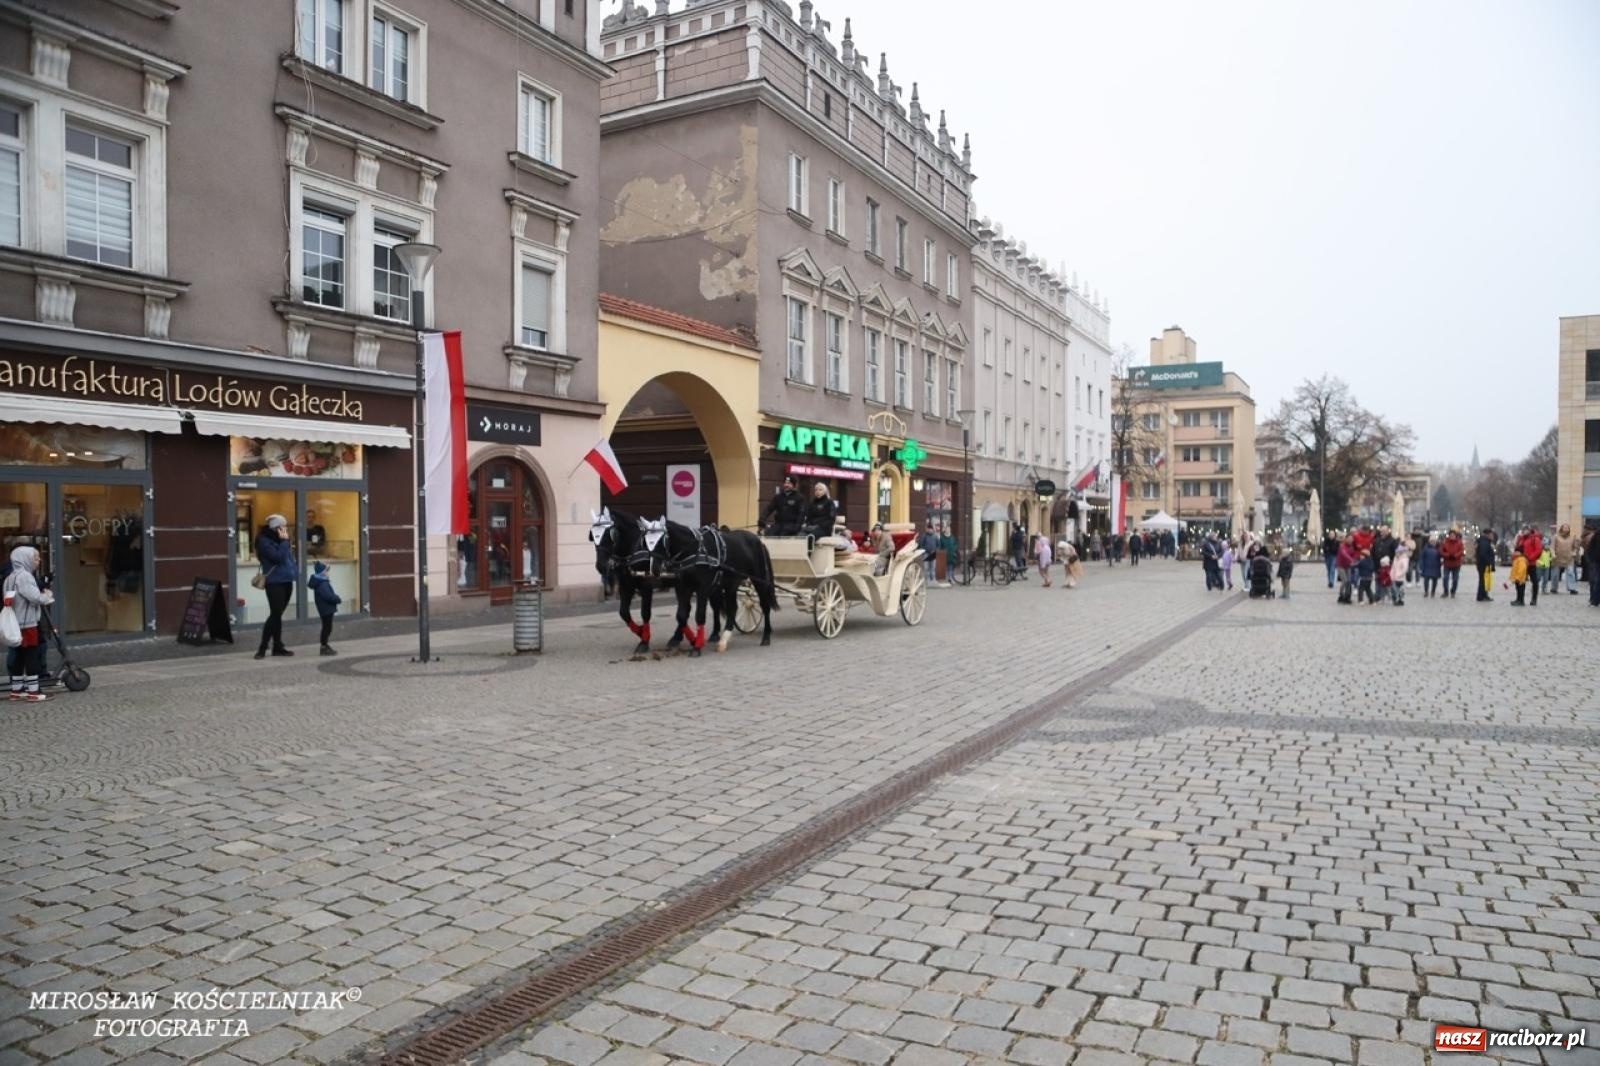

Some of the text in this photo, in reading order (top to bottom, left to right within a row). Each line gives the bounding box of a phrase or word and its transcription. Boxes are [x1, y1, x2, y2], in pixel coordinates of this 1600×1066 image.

[1151, 371, 1199, 381] McDonald's
[175, 374, 261, 409] Lodów
[269, 383, 363, 421] Gałeczka
[777, 424, 871, 462] APTEKA
[70, 515, 133, 538] GOFRY
